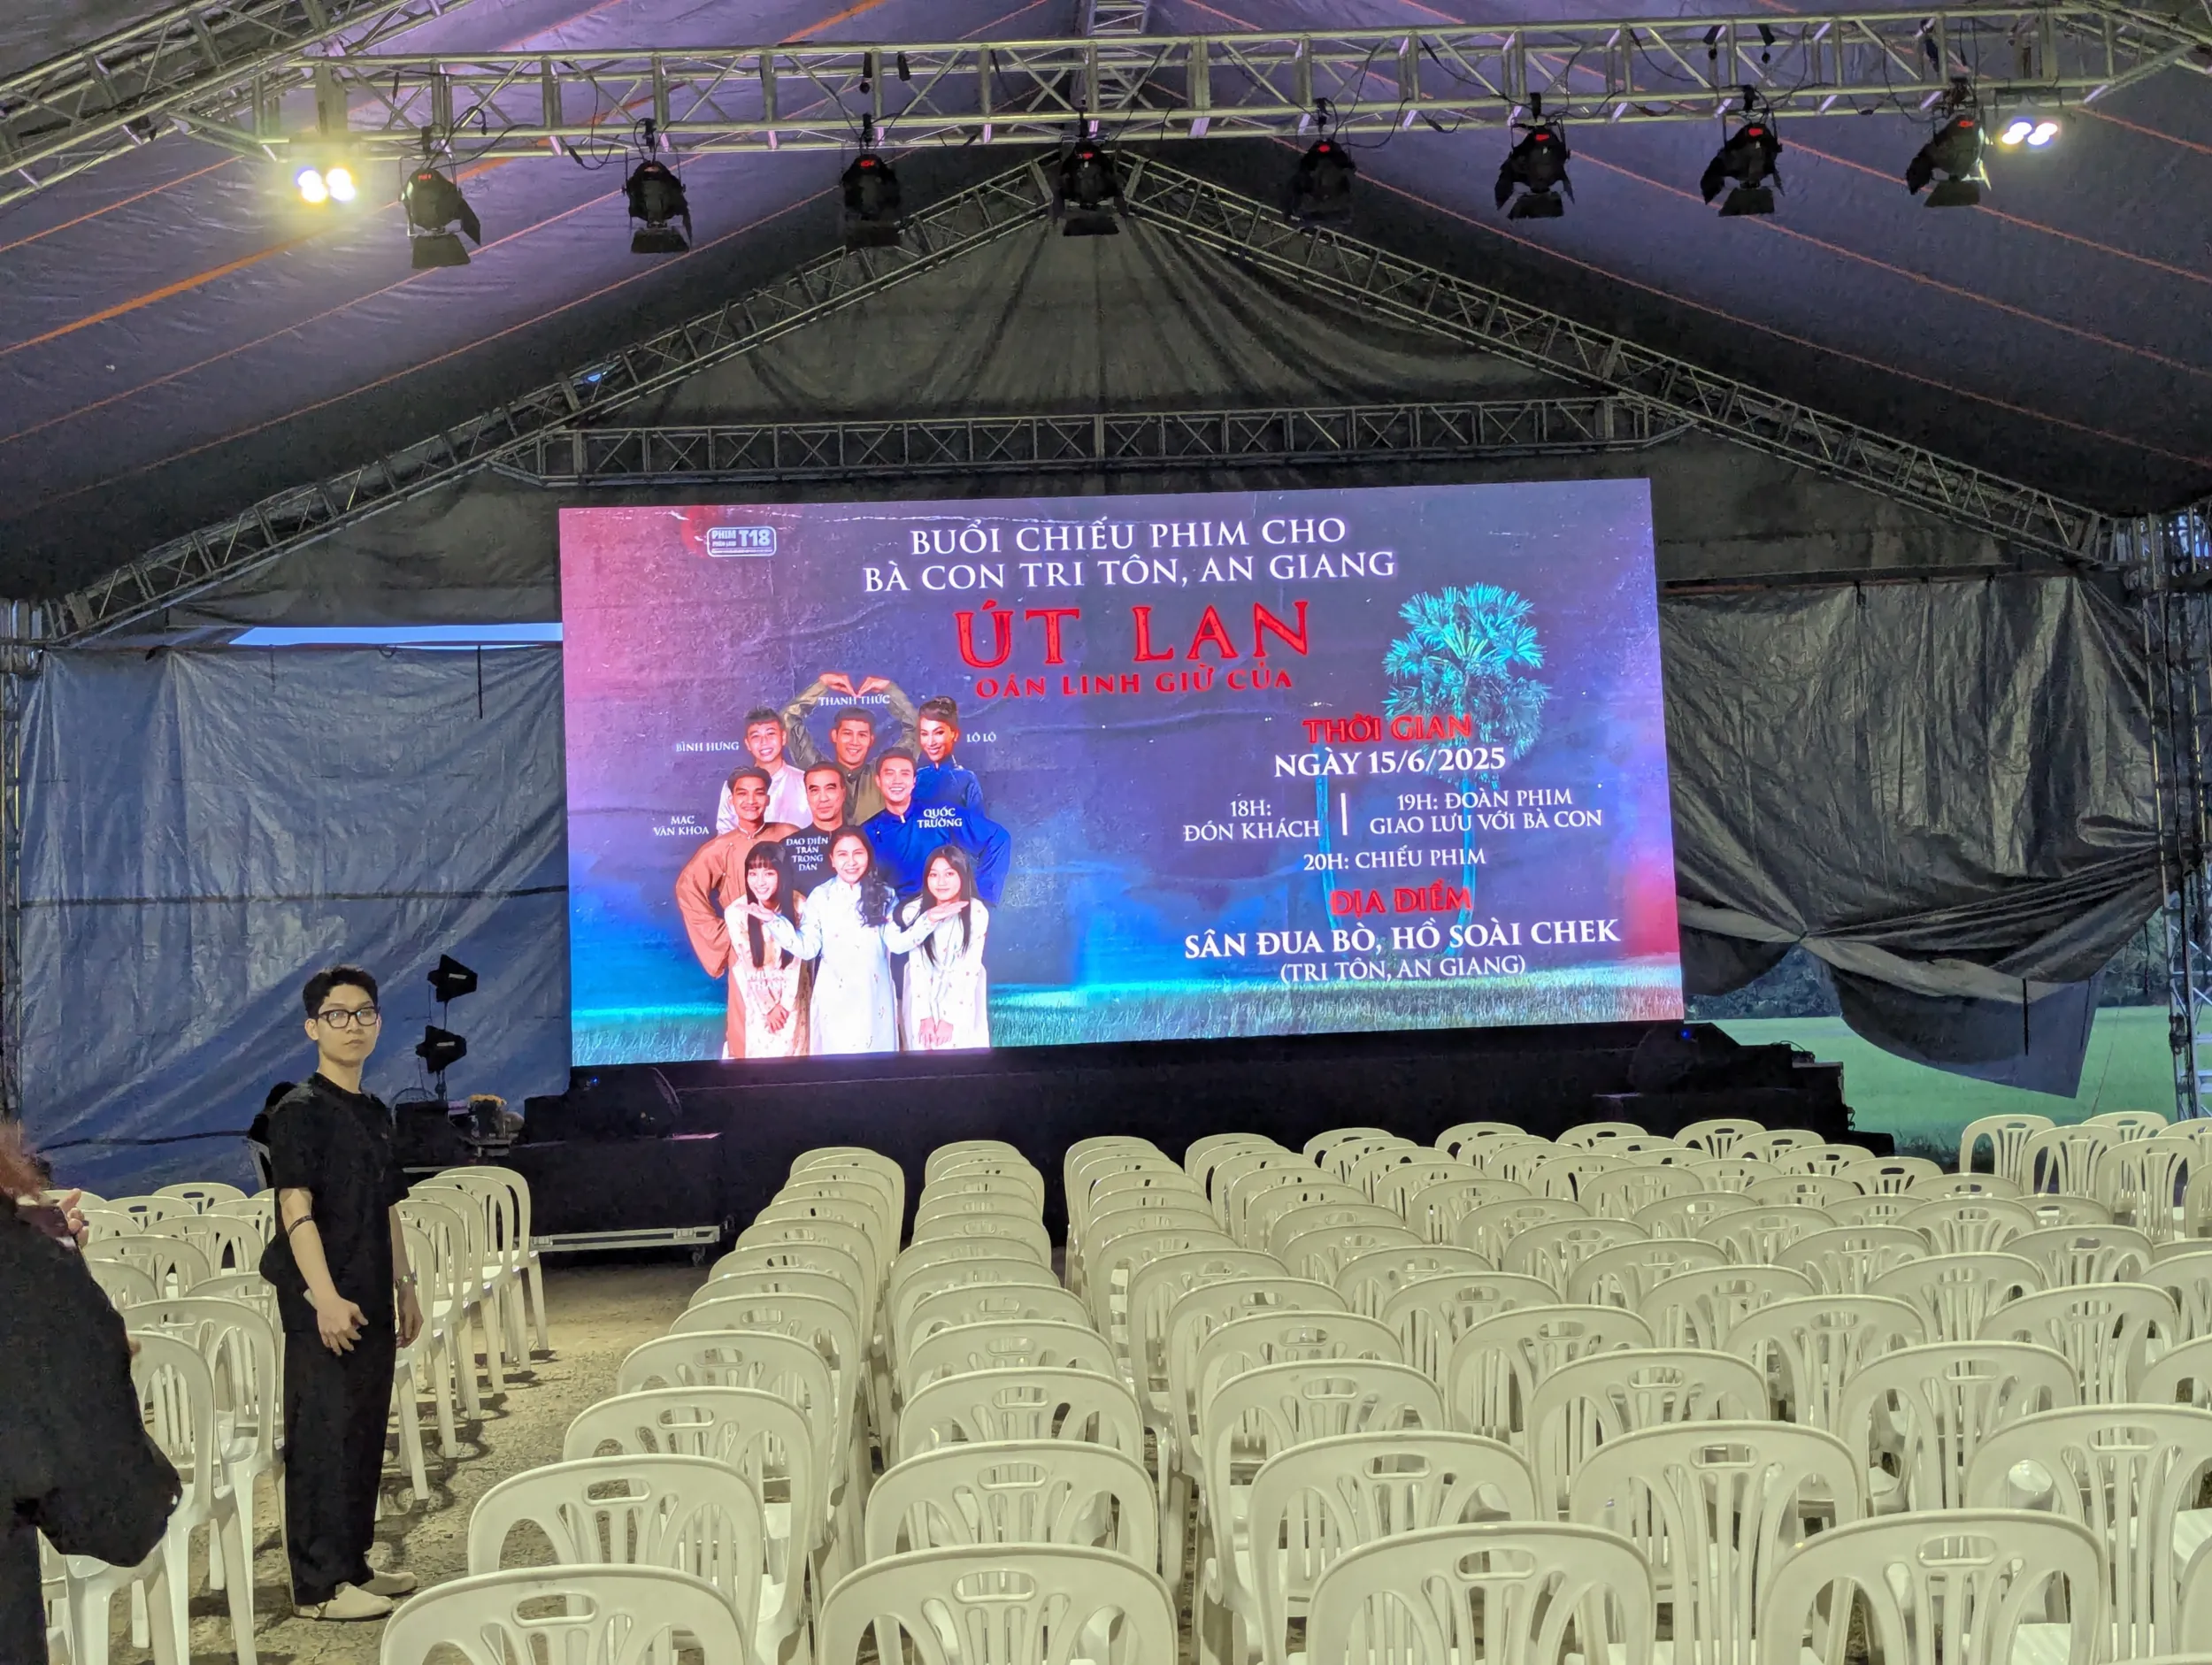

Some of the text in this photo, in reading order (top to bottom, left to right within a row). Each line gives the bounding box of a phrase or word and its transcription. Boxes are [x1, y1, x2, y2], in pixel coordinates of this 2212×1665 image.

[711, 530, 736, 539] PHIM
[738, 529, 771, 547] T18
[910, 516, 1346, 555] BUỔI CHIẾU PHIM CHO
[863, 550, 1395, 592] BÀ CON TRI TÔN, AN GIANG
[954, 599, 1309, 668] ÚT LAN
[1063, 673, 1141, 696] LINH
[1227, 661, 1293, 691] CỦA
[818, 694, 891, 707] THANH THỨC
[1302, 713, 1471, 743] THỜI GIAN
[676, 740, 740, 752] BÌNH HƯNG
[1274, 747, 1506, 778] NGÀY 15/6/2025
[1231, 799, 1272, 817] 18H:
[1398, 786, 1573, 810] 19H: ĐOÀN PHIM
[678, 825, 710, 836] KHOA
[1183, 817, 1321, 842] ĐÓN KHÁCH
[1370, 808, 1602, 834] GIAO LƯU VỚI BÀ CON
[1302, 845, 1487, 871] 20H: CHIẾU PHIM
[1330, 878, 1473, 918] ĐỊA ĐIỂM
[1185, 917, 1622, 959] SÂN ĐUA BÒ, HỒ SOÀI CHEK
[1280, 954, 1526, 985] (TRI TÔN, AN GIANG)
